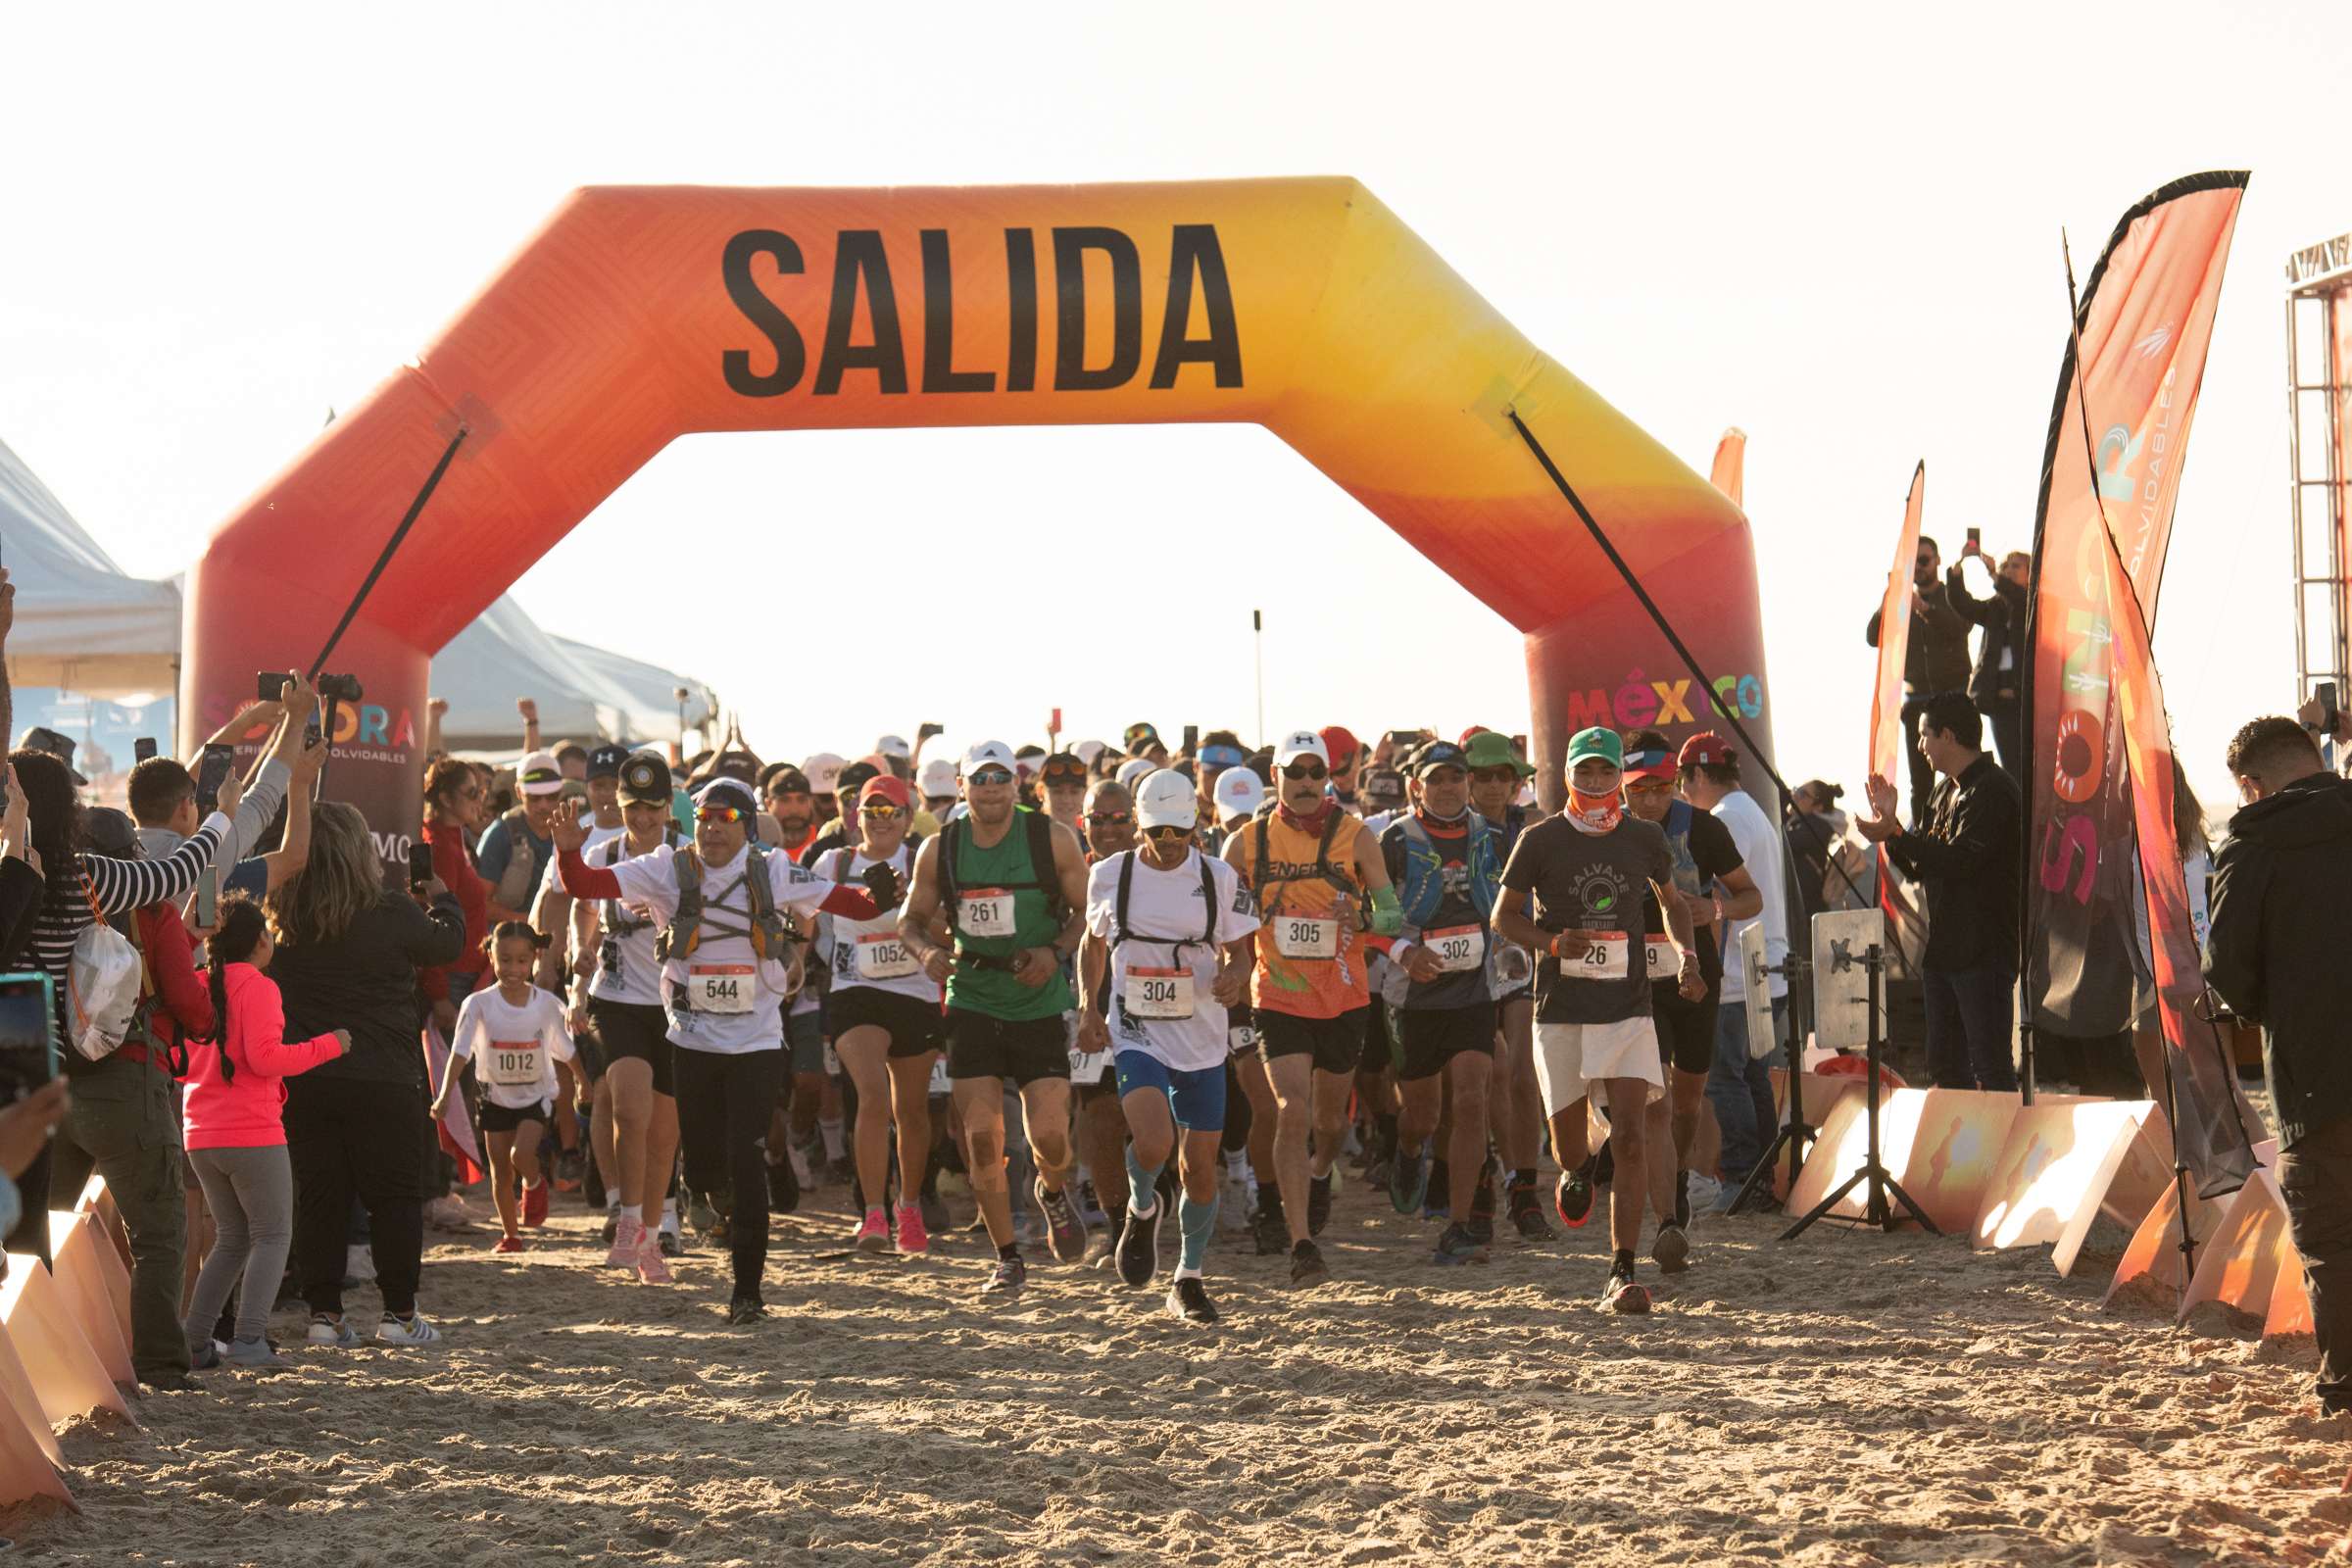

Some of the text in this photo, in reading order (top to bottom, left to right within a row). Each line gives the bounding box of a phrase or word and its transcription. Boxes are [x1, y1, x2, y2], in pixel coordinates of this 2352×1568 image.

[722, 223, 1245, 398] SALIDA
[1568, 862, 1630, 896] SALVAJE
[970, 903, 999, 922] 261
[1290, 922, 1320, 943] 305
[871, 945, 907, 964] 1052
[1443, 939, 1470, 959] 302
[707, 980, 738, 999] 544
[1144, 981, 1176, 1002] 304
[1240, 1028, 1250, 1044] 3
[499, 1054, 534, 1070] 1012
